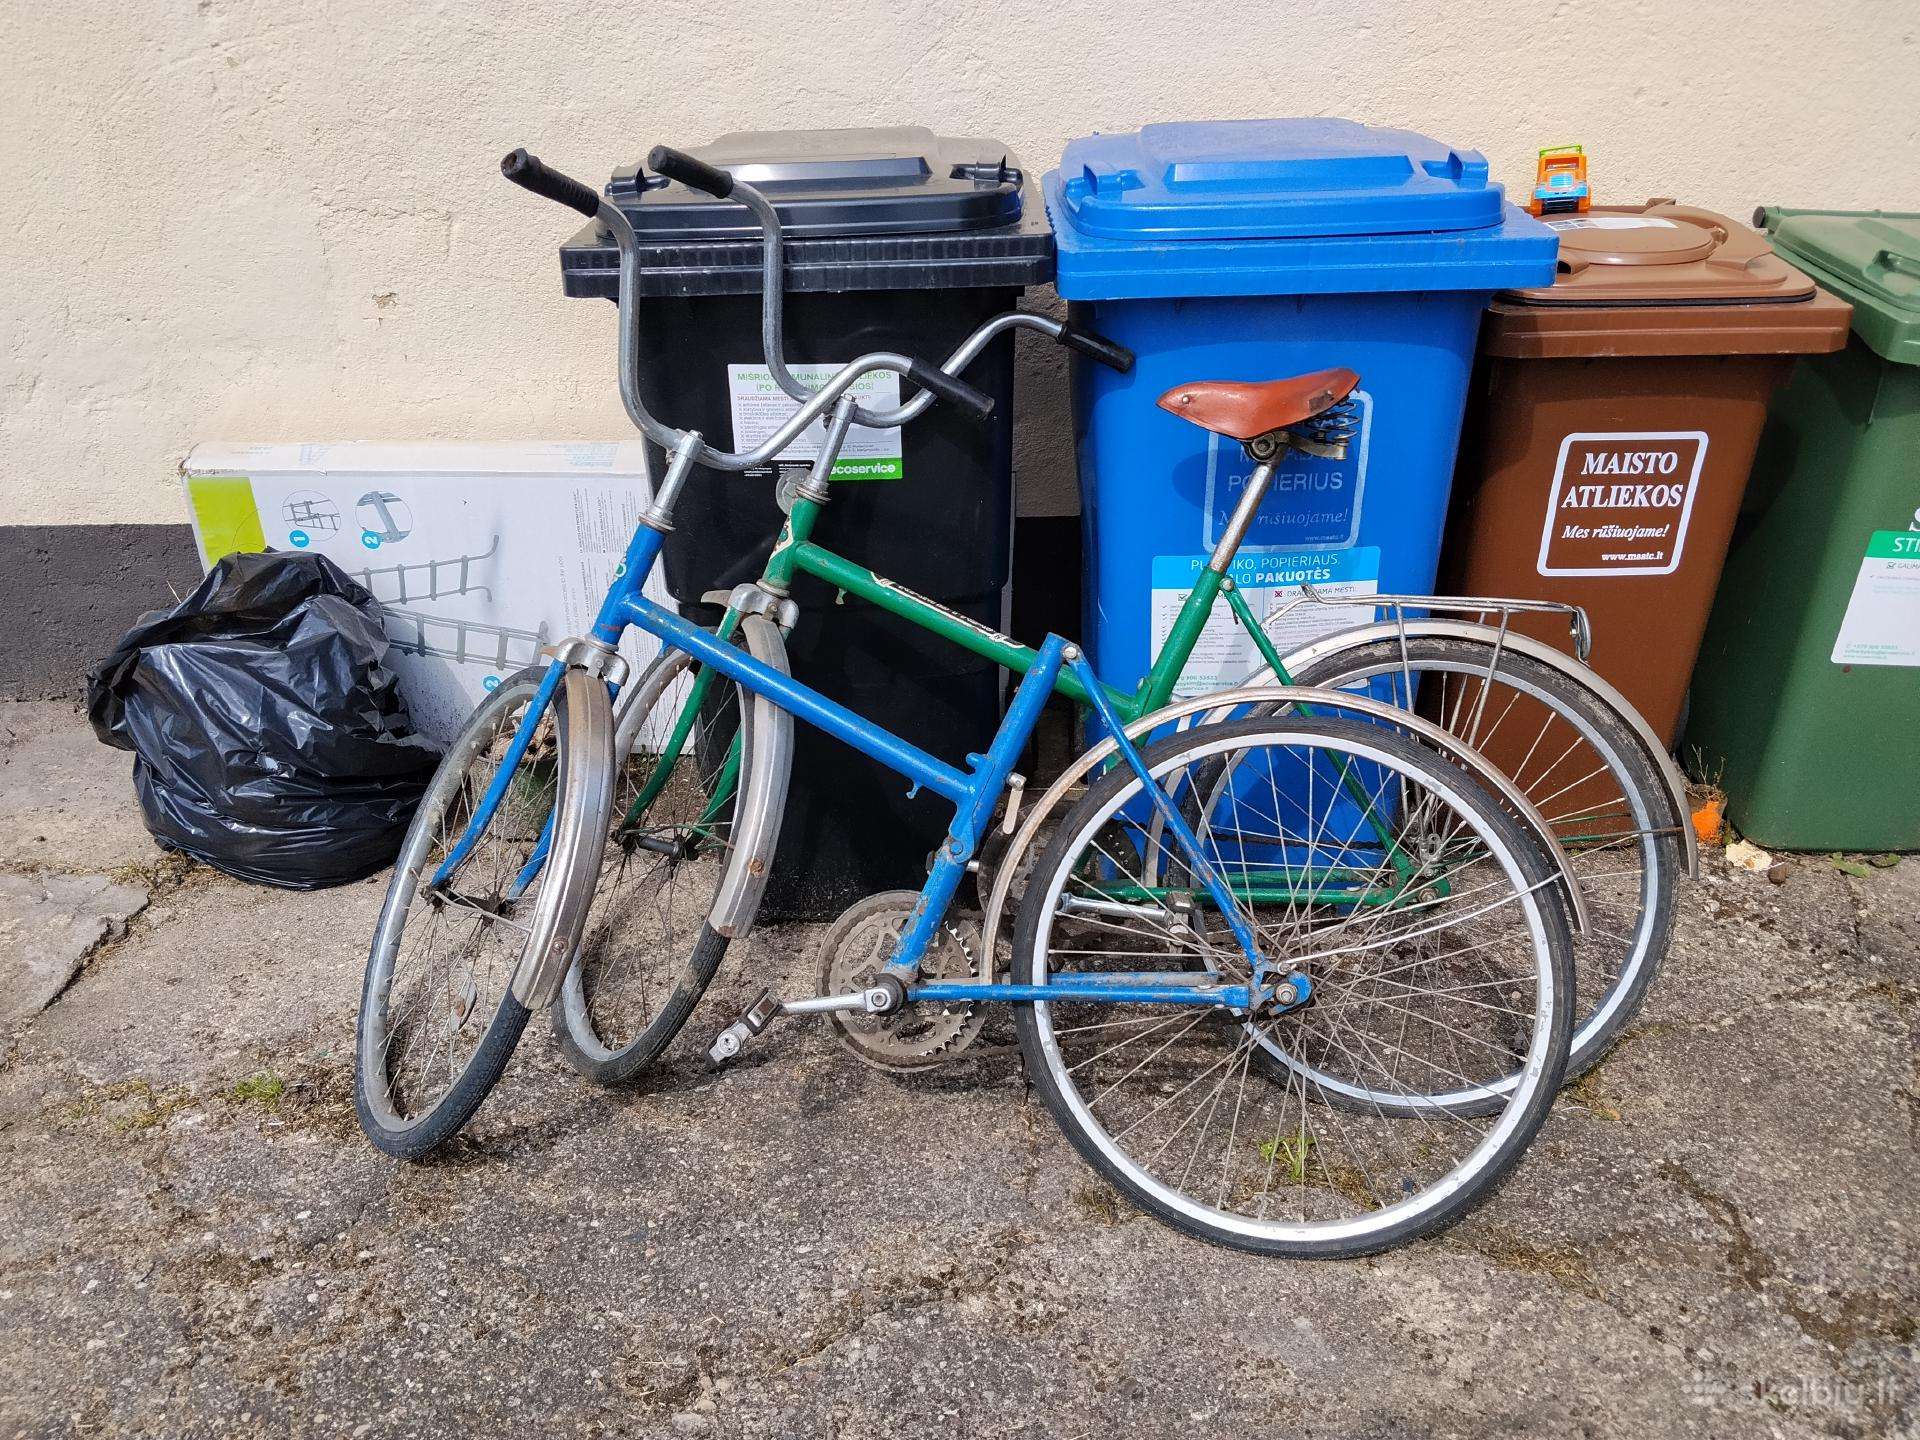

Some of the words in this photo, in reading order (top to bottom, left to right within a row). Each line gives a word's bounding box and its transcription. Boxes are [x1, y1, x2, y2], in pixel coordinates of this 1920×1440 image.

[1580, 452, 1678, 475] MAISTO
[1561, 484, 1684, 508] ATLIEKOS
[1561, 525, 1590, 539] Mes
[1591, 523, 1670, 542] rūšiuojame!
[1892, 537, 1920, 552] STI
[1261, 553, 1342, 569] POPIERIAUS,
[1255, 567, 1331, 584] PAKUOTĖS
